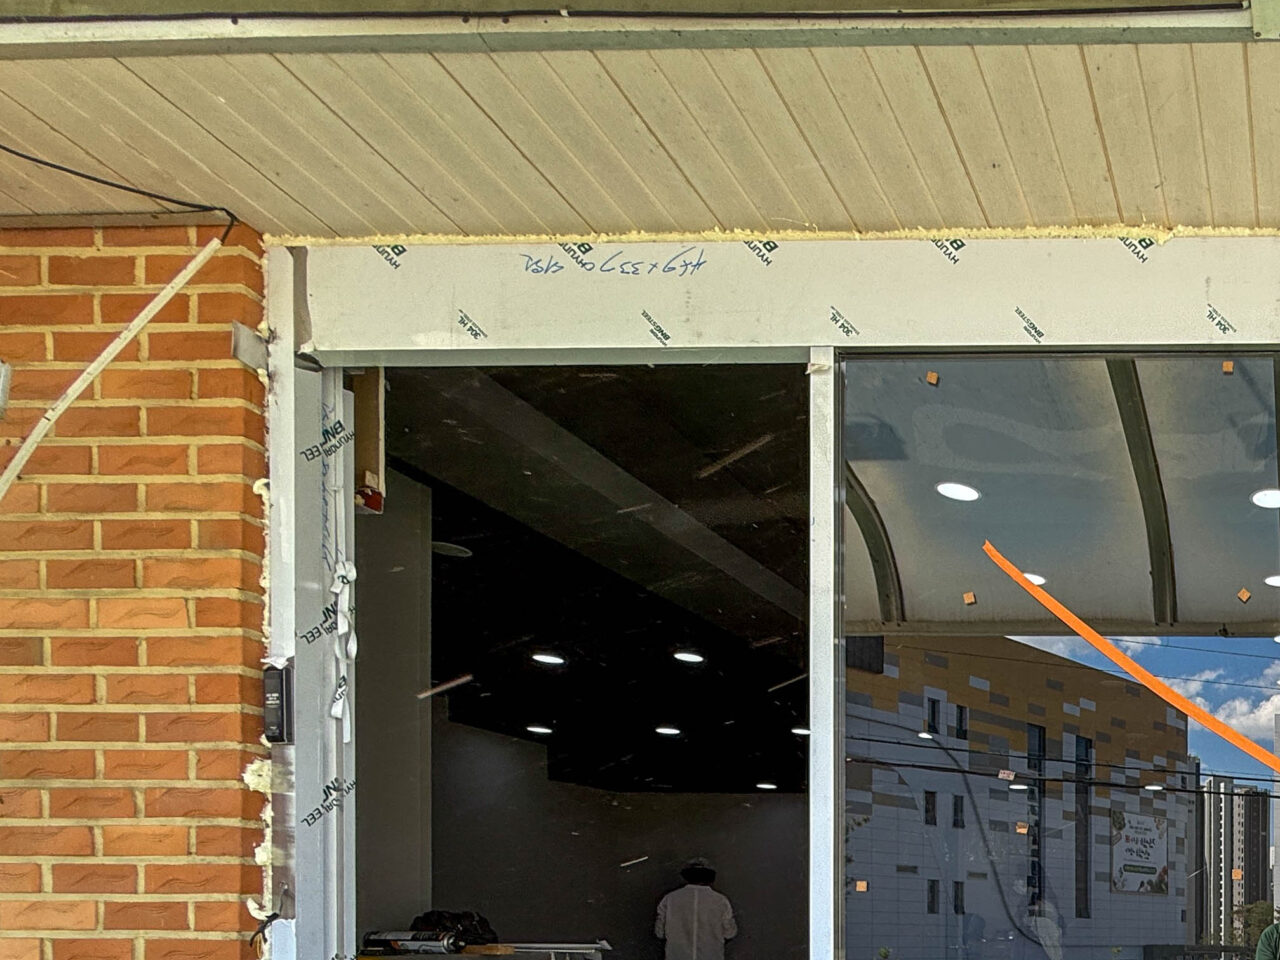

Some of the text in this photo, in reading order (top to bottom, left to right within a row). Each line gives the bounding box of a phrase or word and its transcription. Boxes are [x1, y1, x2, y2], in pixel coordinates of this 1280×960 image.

[371, 243, 400, 270] HYUN
[562, 242, 591, 273] HYUN
[742, 240, 772, 267] HYUN
[930, 238, 960, 265] HYUN
[1117, 236, 1147, 264] HYUN
